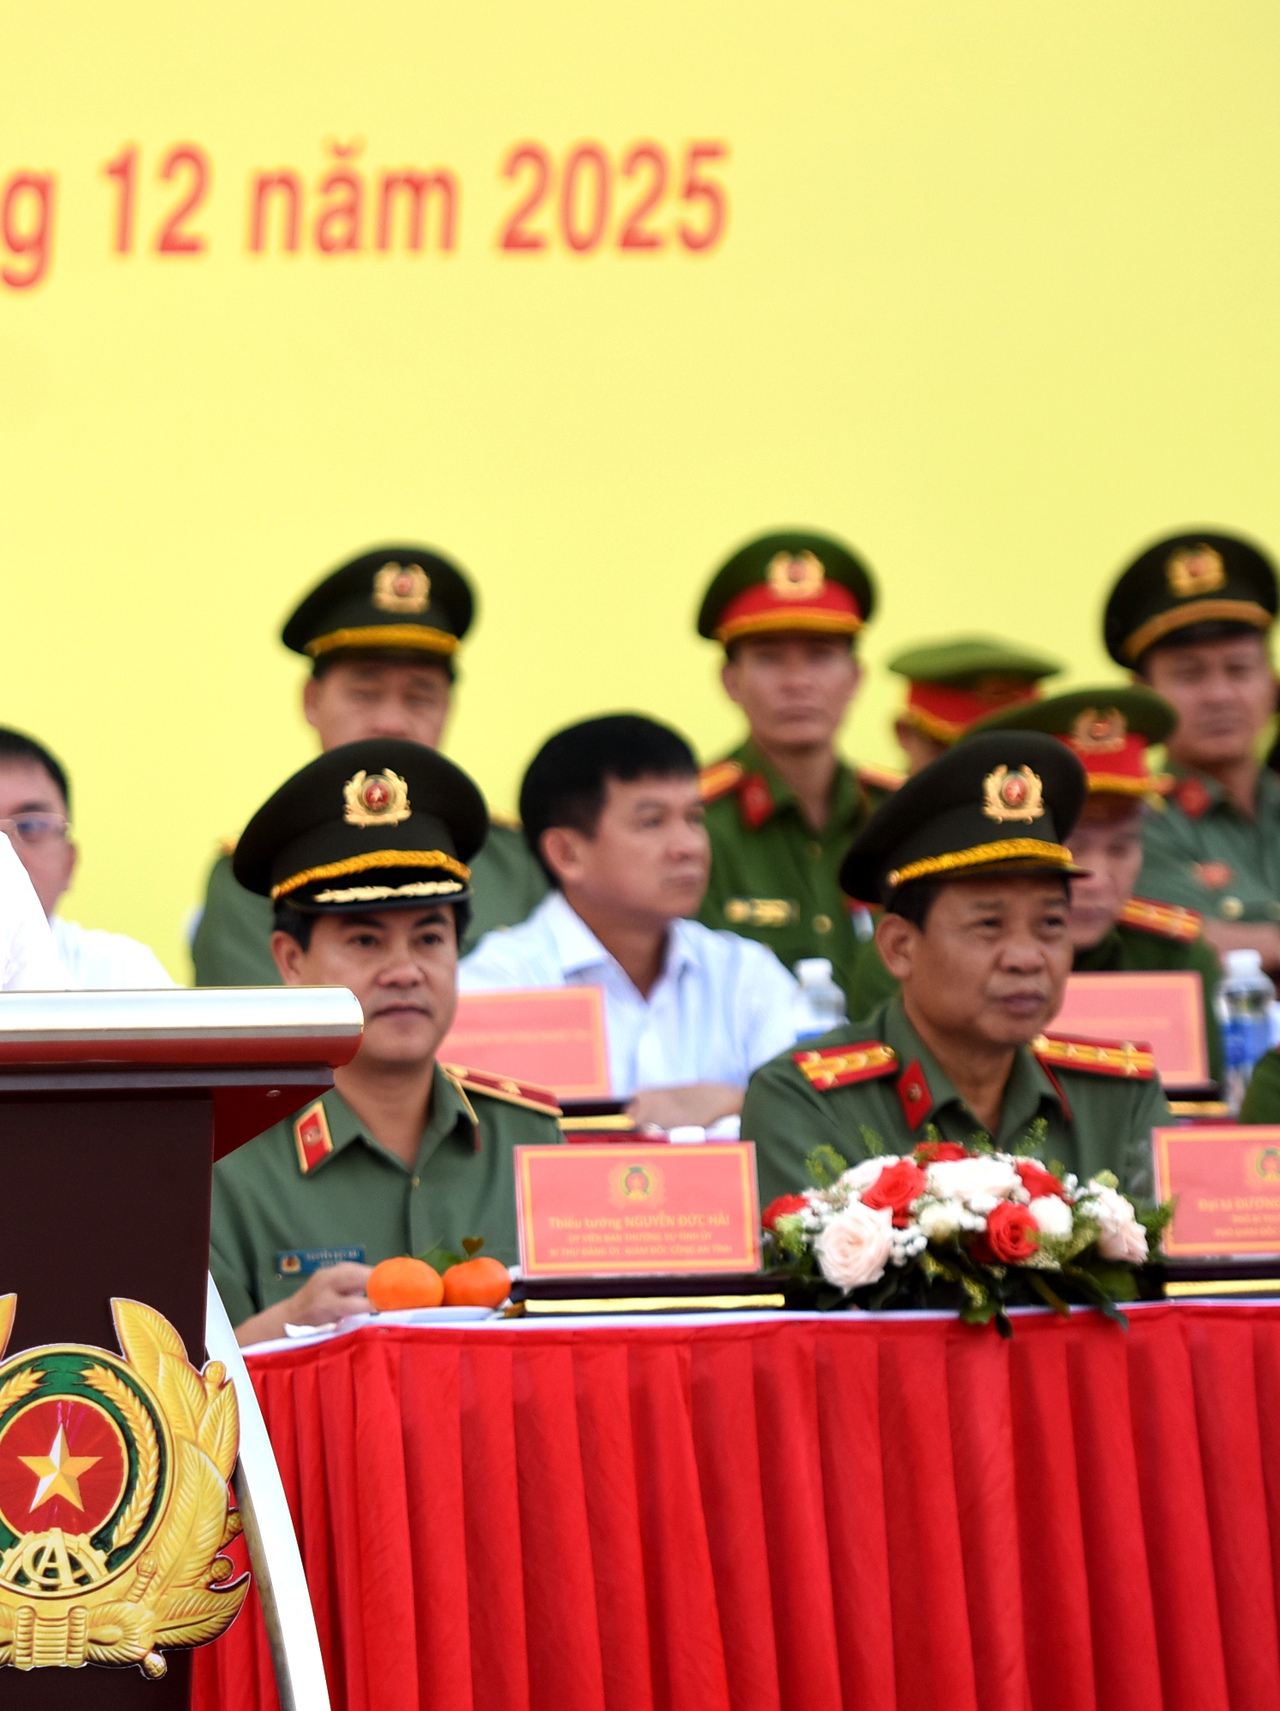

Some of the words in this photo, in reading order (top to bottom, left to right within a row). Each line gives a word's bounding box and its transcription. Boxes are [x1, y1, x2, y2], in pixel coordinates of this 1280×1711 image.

[102, 142, 211, 257] 12
[248, 138, 460, 257] năm
[496, 141, 728, 256] 2025
[625, 1210, 675, 1228] NGUYỄN
